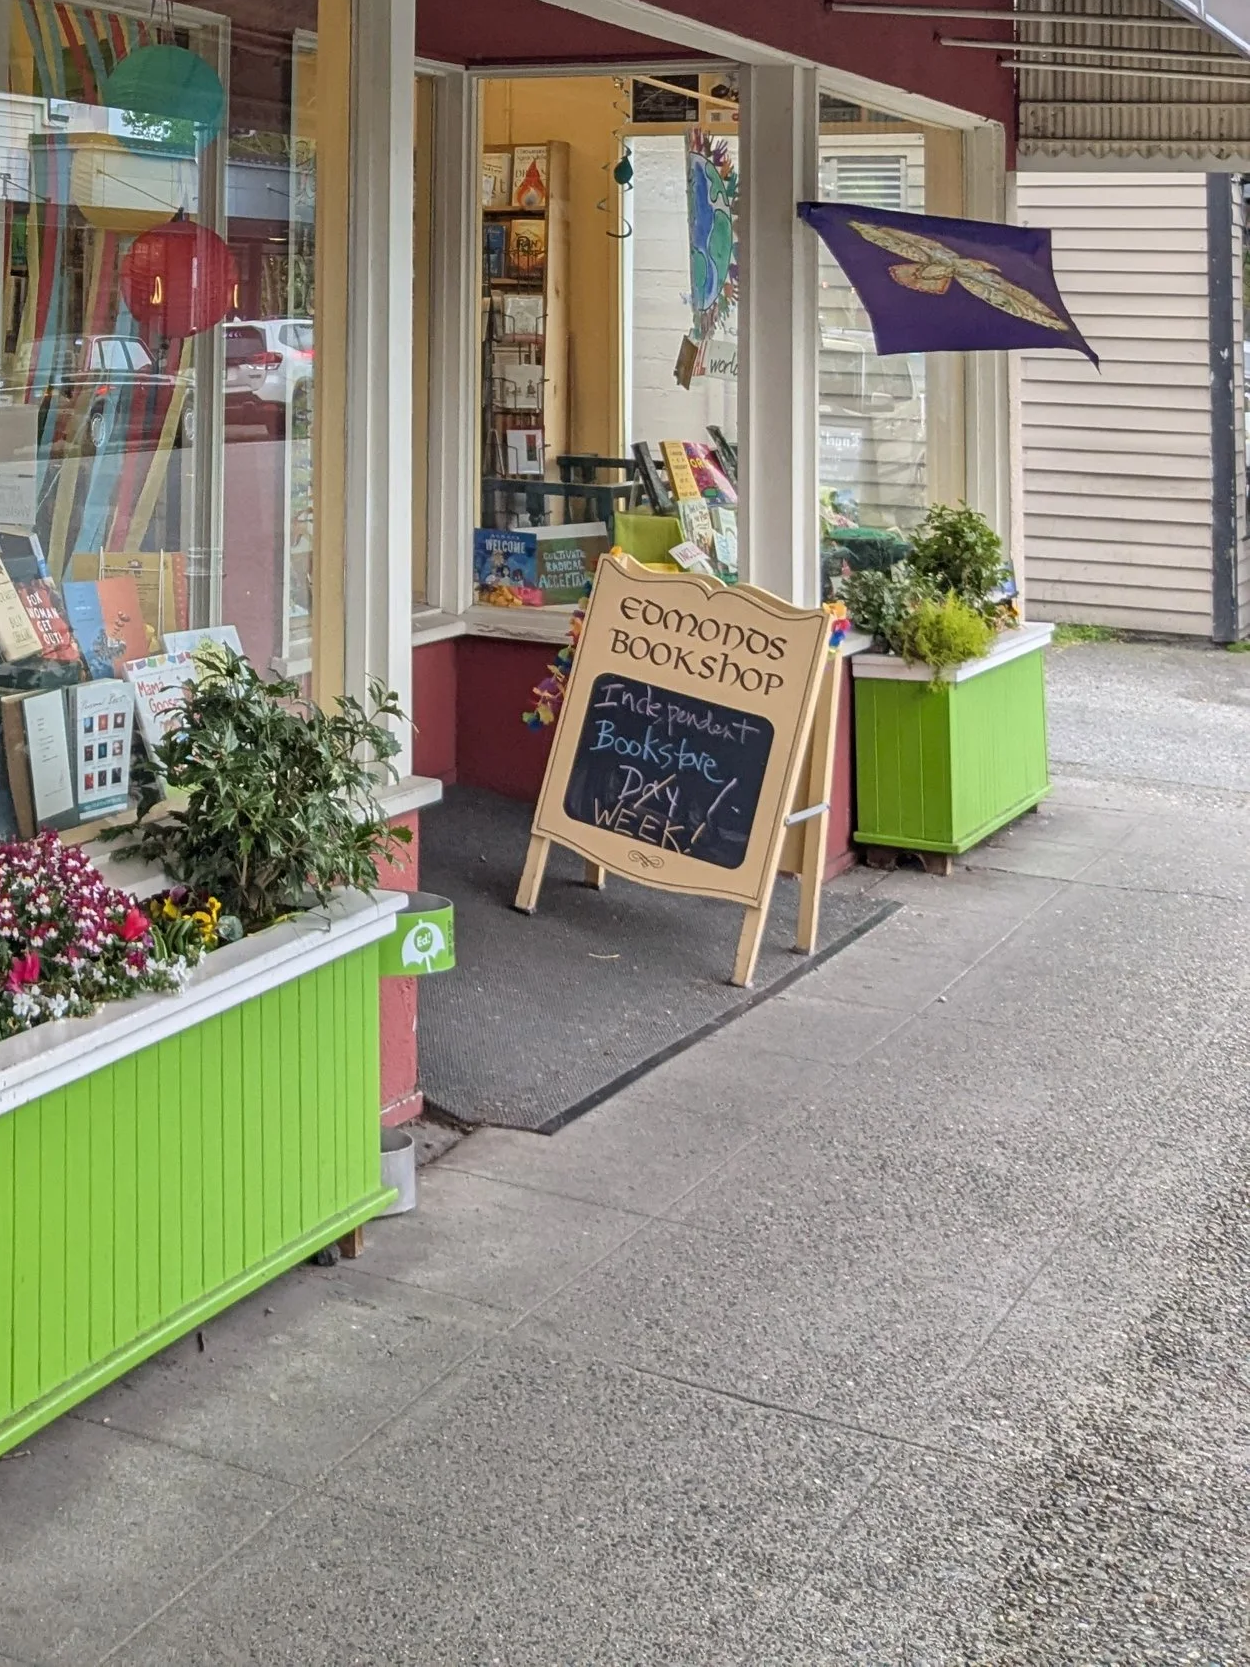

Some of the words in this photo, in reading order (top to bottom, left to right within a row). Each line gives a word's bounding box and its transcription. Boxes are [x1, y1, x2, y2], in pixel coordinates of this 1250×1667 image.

[485, 538, 526, 554] WELCOME
[546, 560, 585, 572] RADICAL
[26, 591, 42, 607] FOX
[28, 607, 60, 620] WOMAN
[37, 620, 53, 631] GET
[619, 596, 788, 660] EDMONDS
[43, 632, 64, 645] OUT!
[609, 628, 784, 695] BOOKSHOP
[589, 720, 726, 783] Bookstore
[593, 798, 706, 854] WEEK!
[416, 932, 431, 948] Ed!
